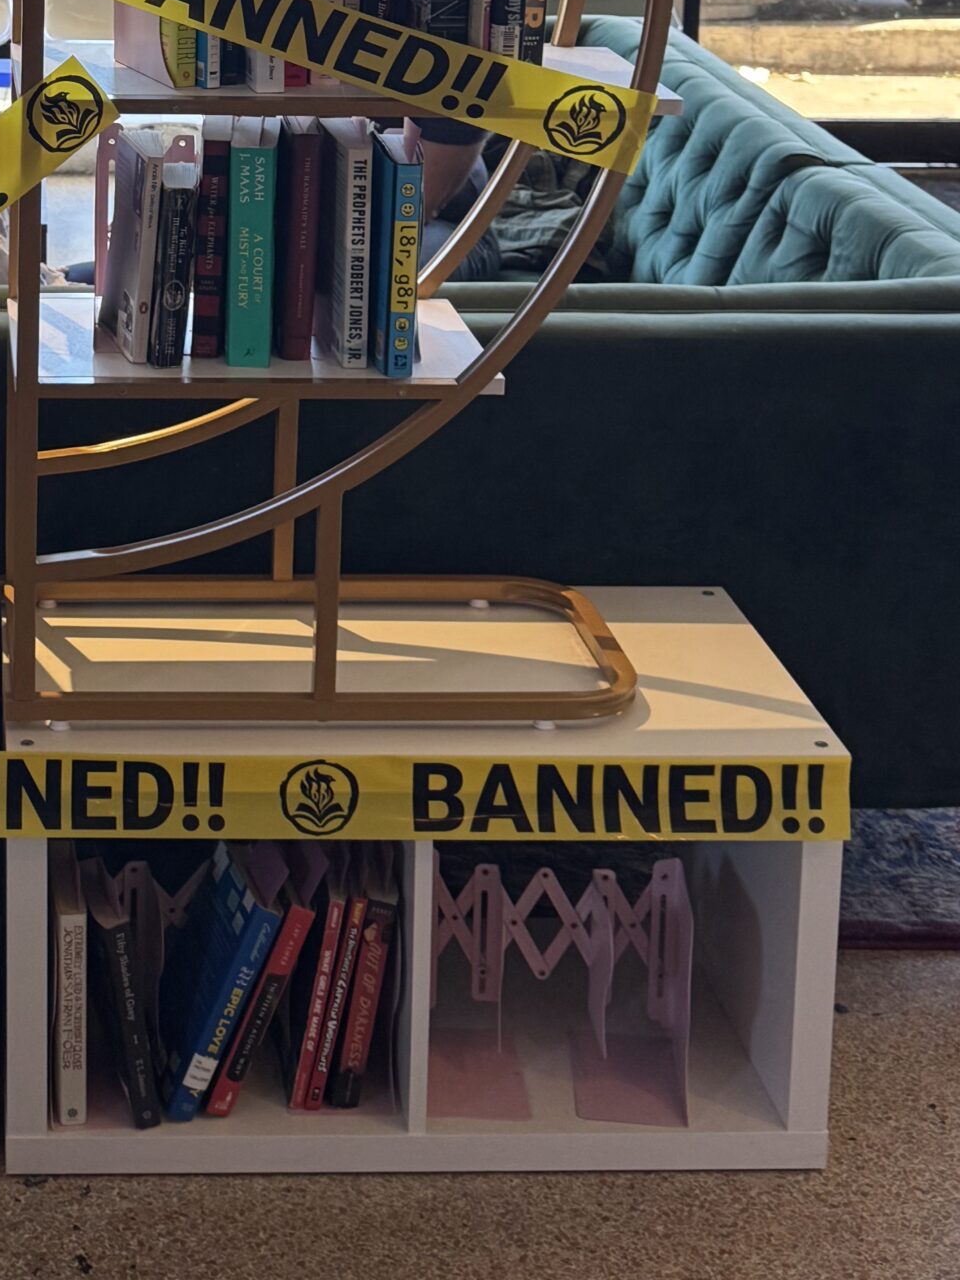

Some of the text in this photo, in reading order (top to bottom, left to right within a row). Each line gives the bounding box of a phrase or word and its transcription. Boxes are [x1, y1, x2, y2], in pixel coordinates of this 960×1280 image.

[174, 36, 193, 69] GIRL
[238, 153, 251, 203] J. MAAS
[253, 156, 265, 200] SARAH
[238, 225, 249, 256] MIST
[252, 233, 264, 292] A COURT
[345, 158, 367, 364] THE PROPHETS ROBERT JONES, JR.
[393, 224, 416, 309] l8r, g8r
[236, 276, 248, 309] FURY
[413, 761, 827, 834] BANNED!!
[62, 927, 73, 1070] JONATHAN SAFRAN FOER
[205, 985, 245, 1054] EPIC LOVE
[347, 942, 382, 1068] OUT OF DARKNESS
